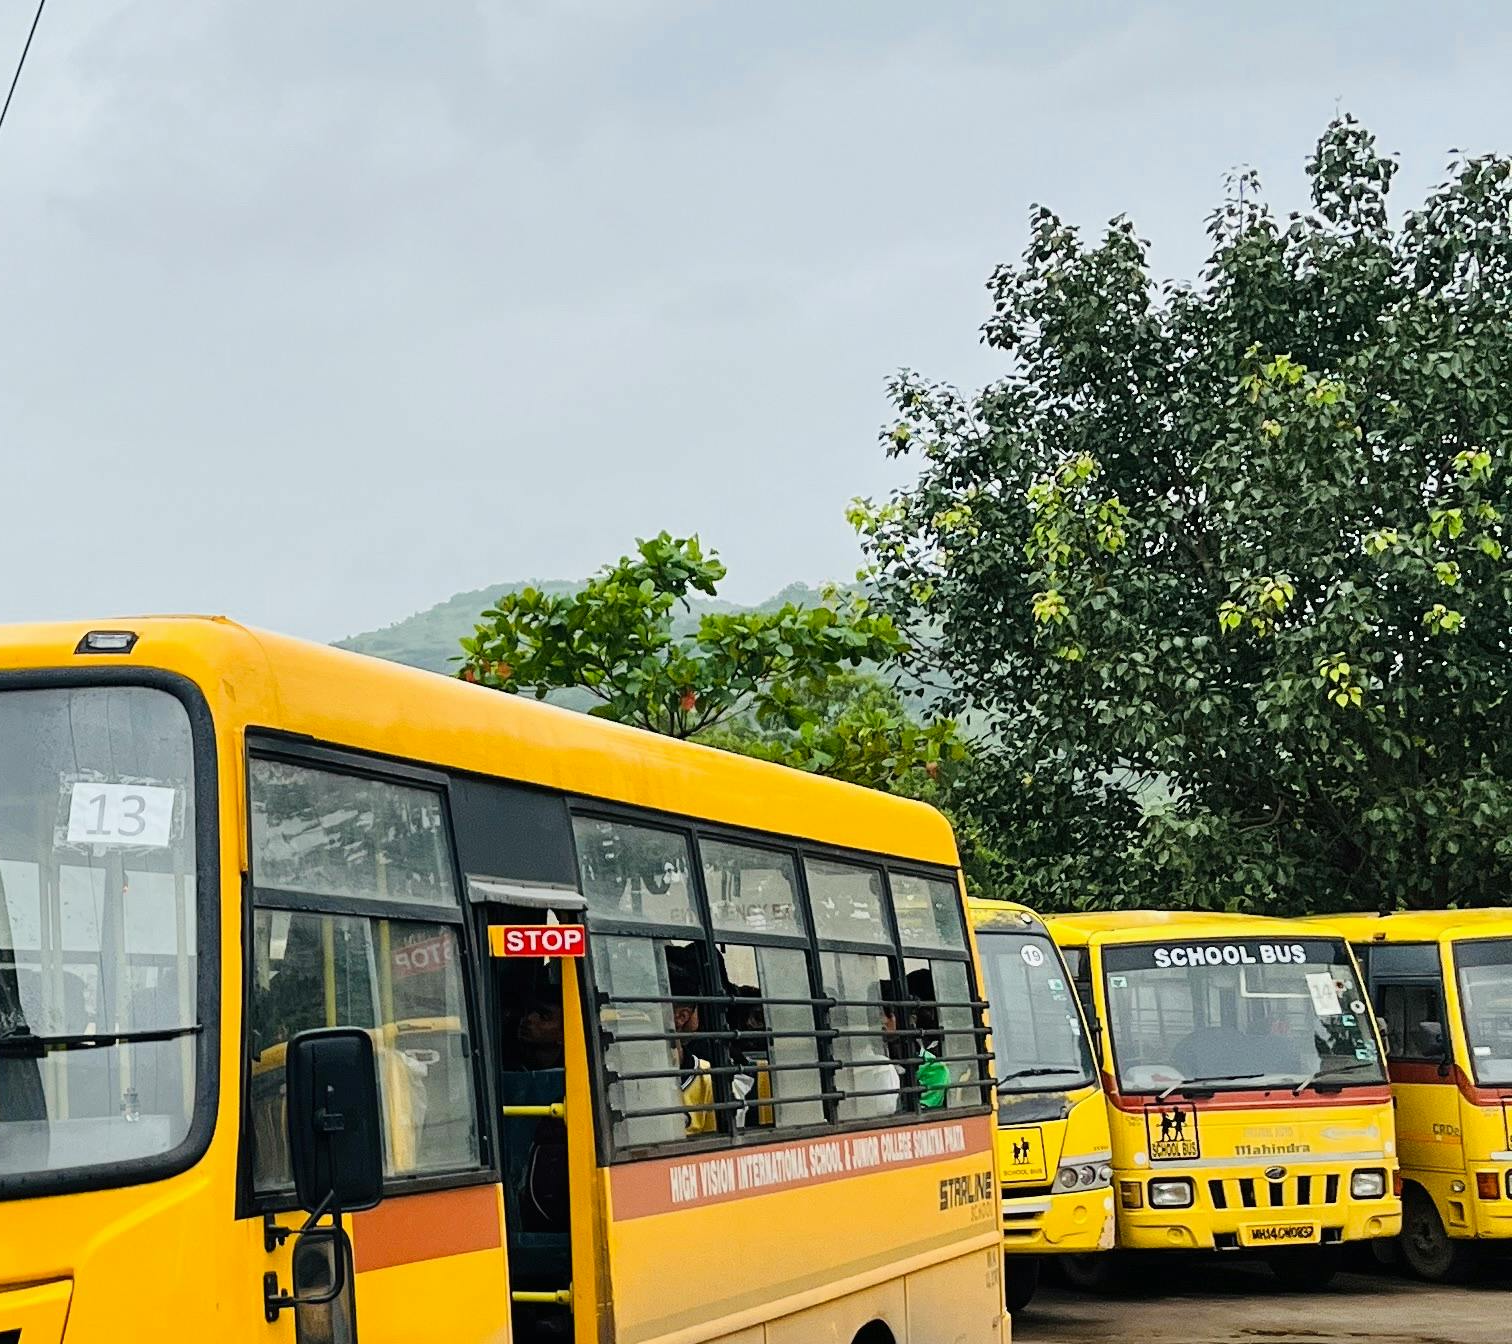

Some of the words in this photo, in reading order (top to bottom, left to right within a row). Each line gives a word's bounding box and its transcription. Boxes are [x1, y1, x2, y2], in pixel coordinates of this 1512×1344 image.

[86, 793, 147, 837] 13
[506, 929, 582, 953] STOP
[1023, 948, 1042, 963] 19
[1154, 945, 1256, 968] SCHOOL
[1259, 944, 1307, 965] BUS
[1151, 1142, 1181, 1158] SCHOOL
[1182, 1141, 1197, 1156] BUS
[669, 1163, 698, 1203] HIGH
[699, 1157, 736, 1197] VISION
[736, 1146, 809, 1190] INTERNATIONAL
[808, 1141, 844, 1177] SCHOOL
[939, 1171, 992, 1211] STARLINE
